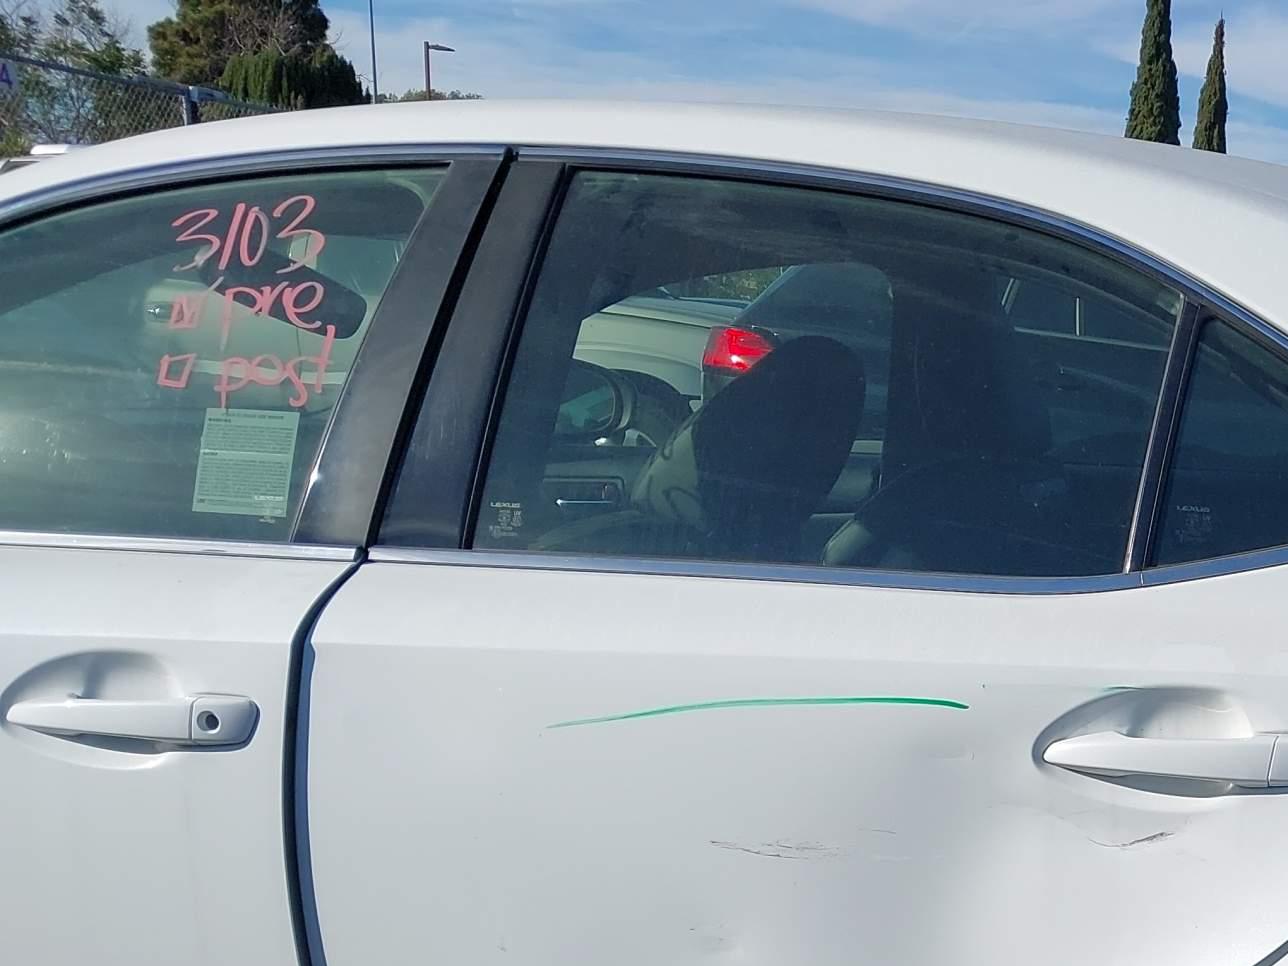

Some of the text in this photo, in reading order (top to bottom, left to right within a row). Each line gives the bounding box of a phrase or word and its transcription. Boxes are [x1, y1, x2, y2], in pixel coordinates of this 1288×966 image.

[171, 195, 326, 274] 3103
[220, 281, 325, 351] pre
[213, 325, 336, 408] post
